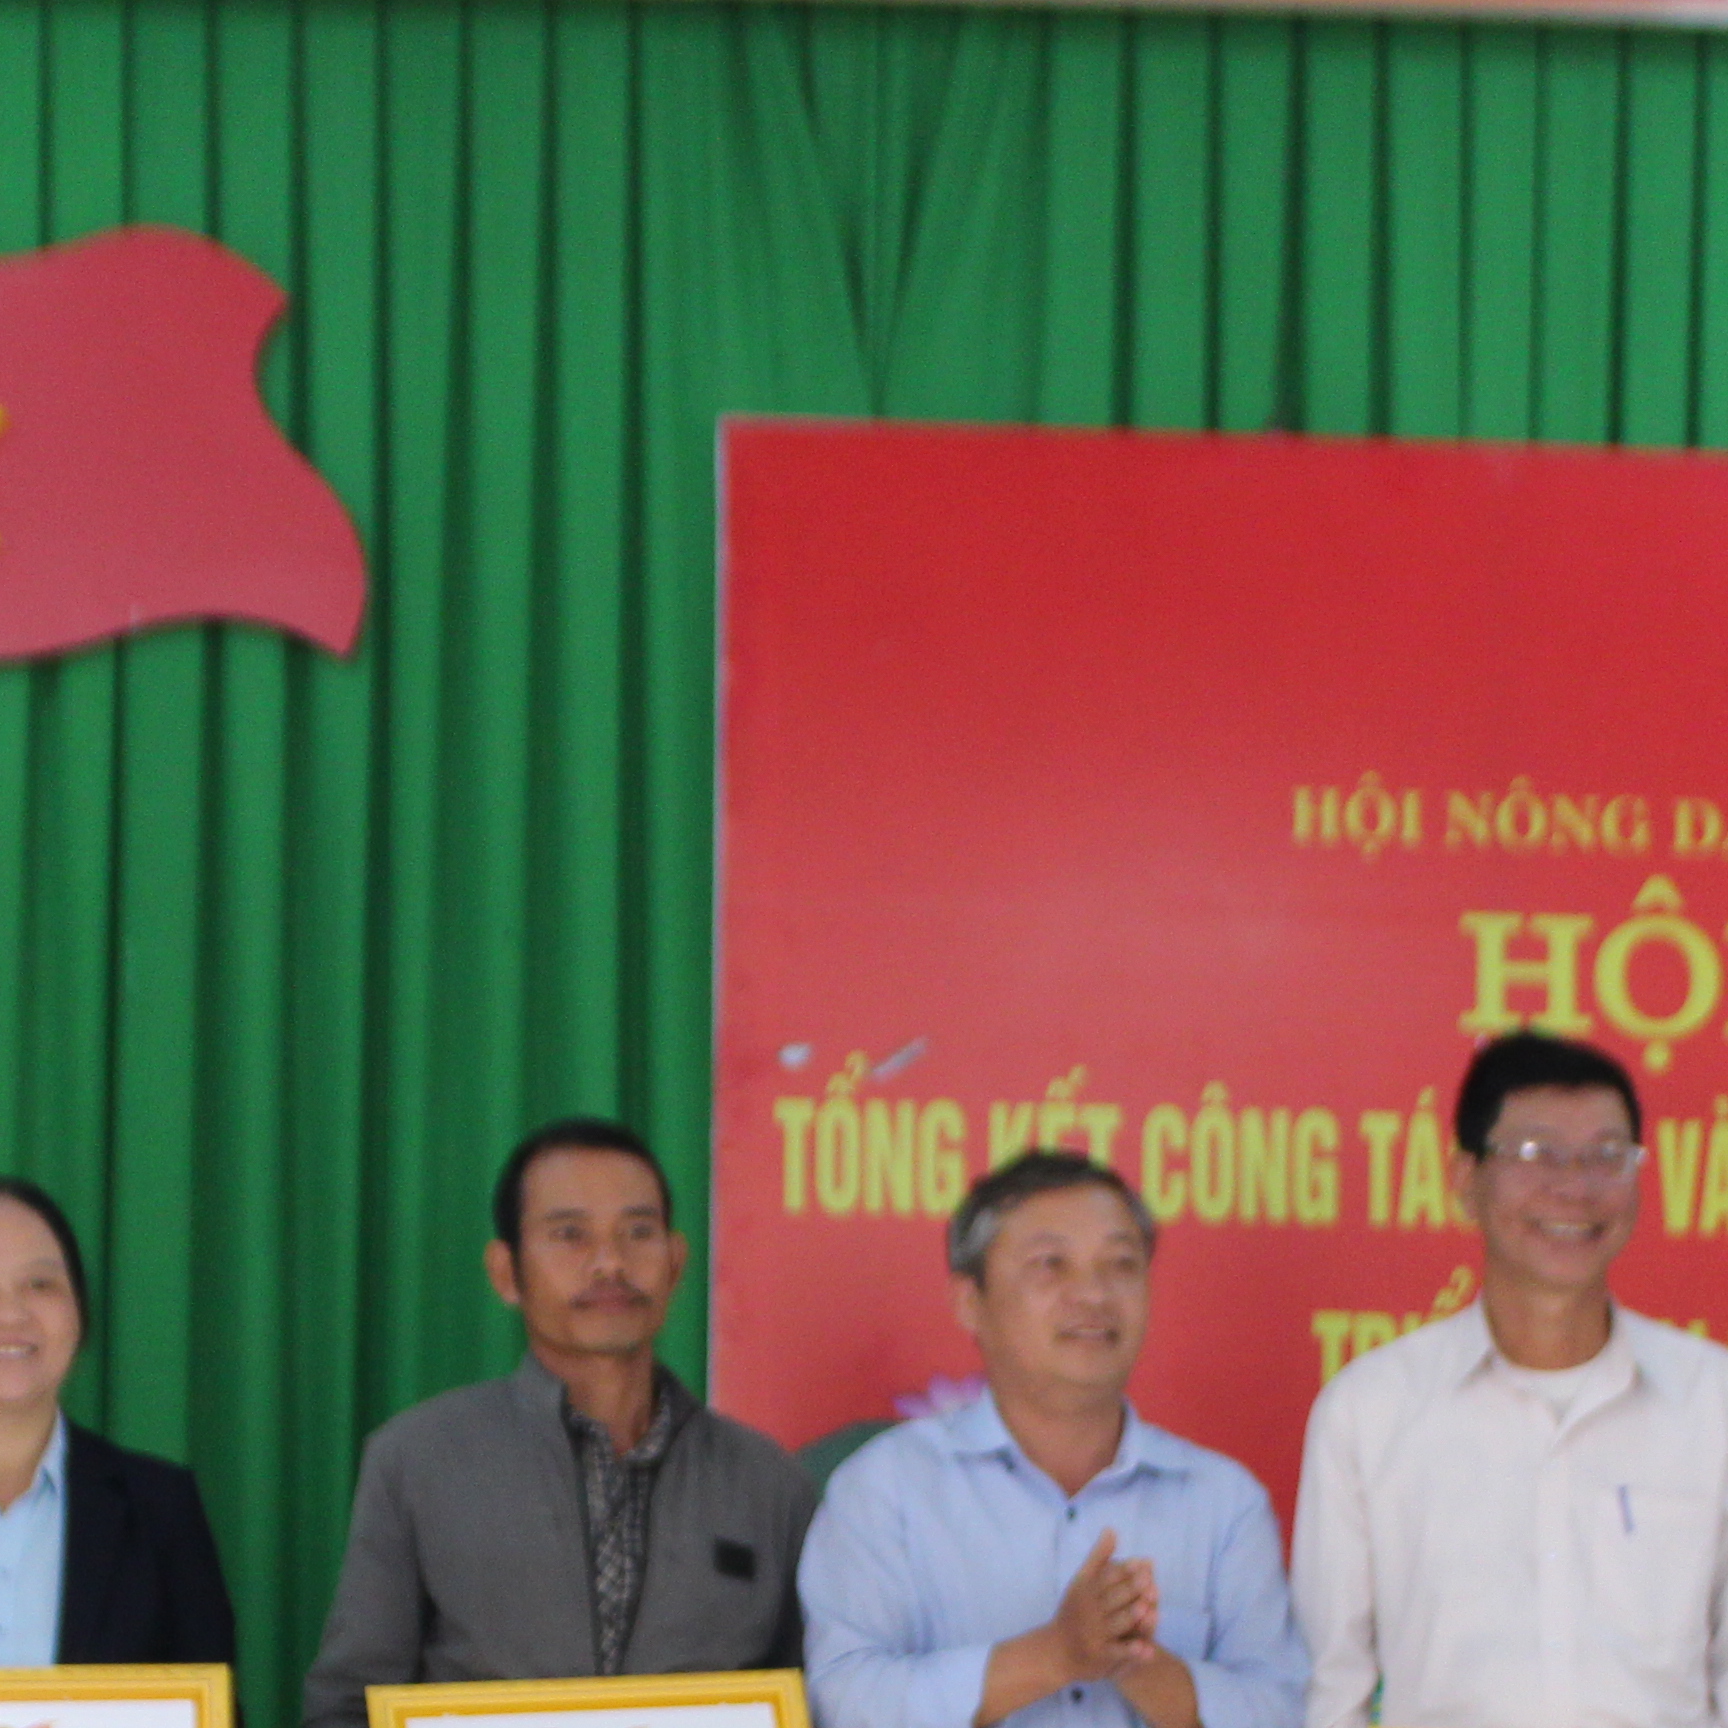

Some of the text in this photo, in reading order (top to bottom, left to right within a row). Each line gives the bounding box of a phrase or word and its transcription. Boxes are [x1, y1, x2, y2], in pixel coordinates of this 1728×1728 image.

[1291, 769, 1426, 864] HỘI
[1443, 775, 1654, 856] NÔNG
[772, 1050, 971, 1220] TỔNG
[1139, 1080, 1344, 1230] CÔNG
[1358, 1085, 1480, 1232] TÁ
